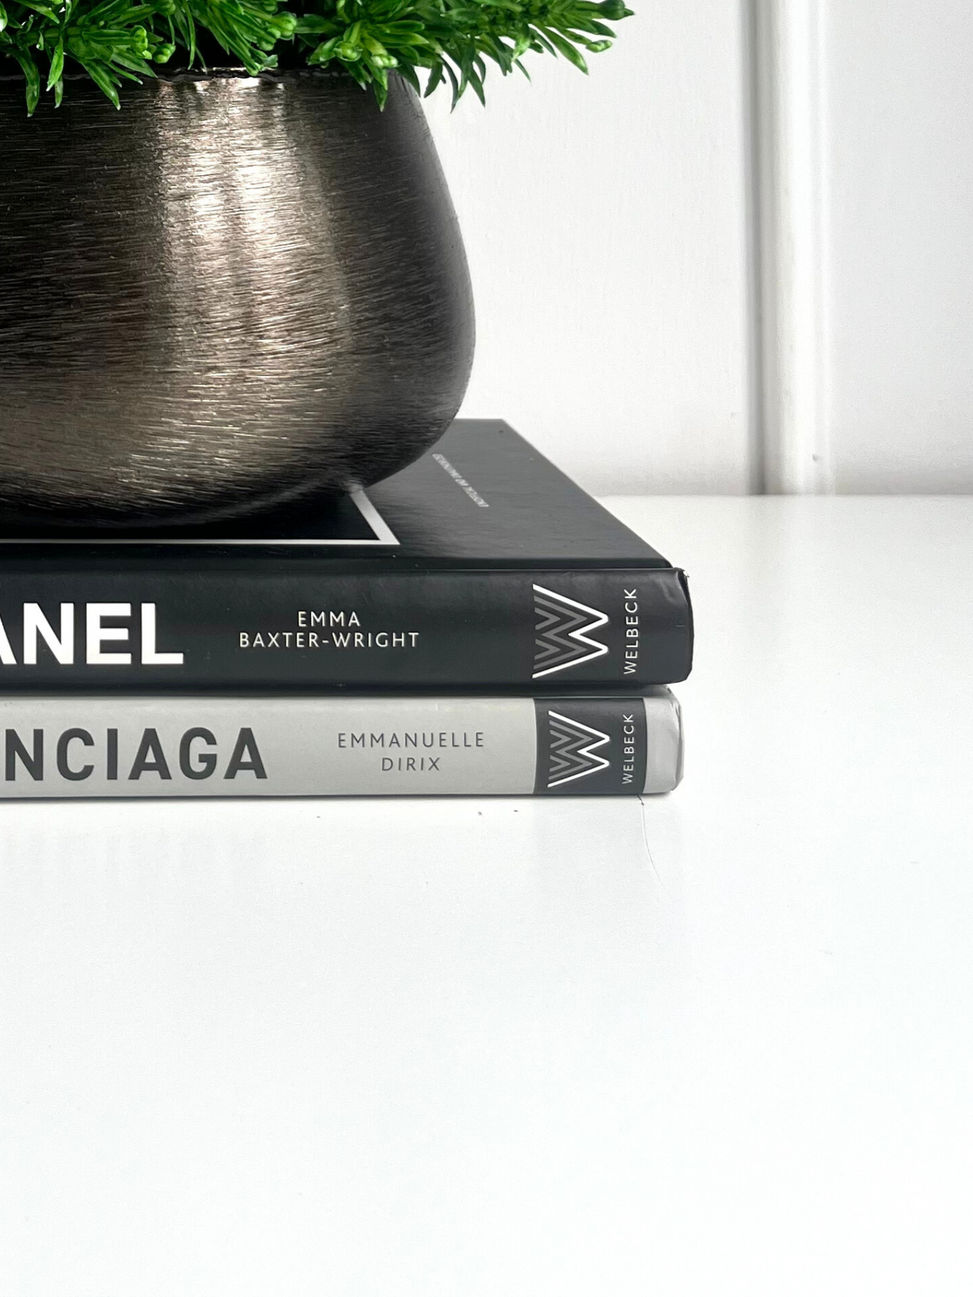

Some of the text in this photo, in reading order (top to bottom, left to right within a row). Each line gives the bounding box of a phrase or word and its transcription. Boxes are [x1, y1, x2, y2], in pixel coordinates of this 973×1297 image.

[297, 611, 361, 628] EMMA
[239, 632, 419, 648] BAXTER-WRIGHT
[623, 588, 639, 675] WELBECK
[337, 731, 485, 749] EMMANUELLE
[622, 714, 635, 784] WELBECK
[381, 757, 441, 772] DIRIX
